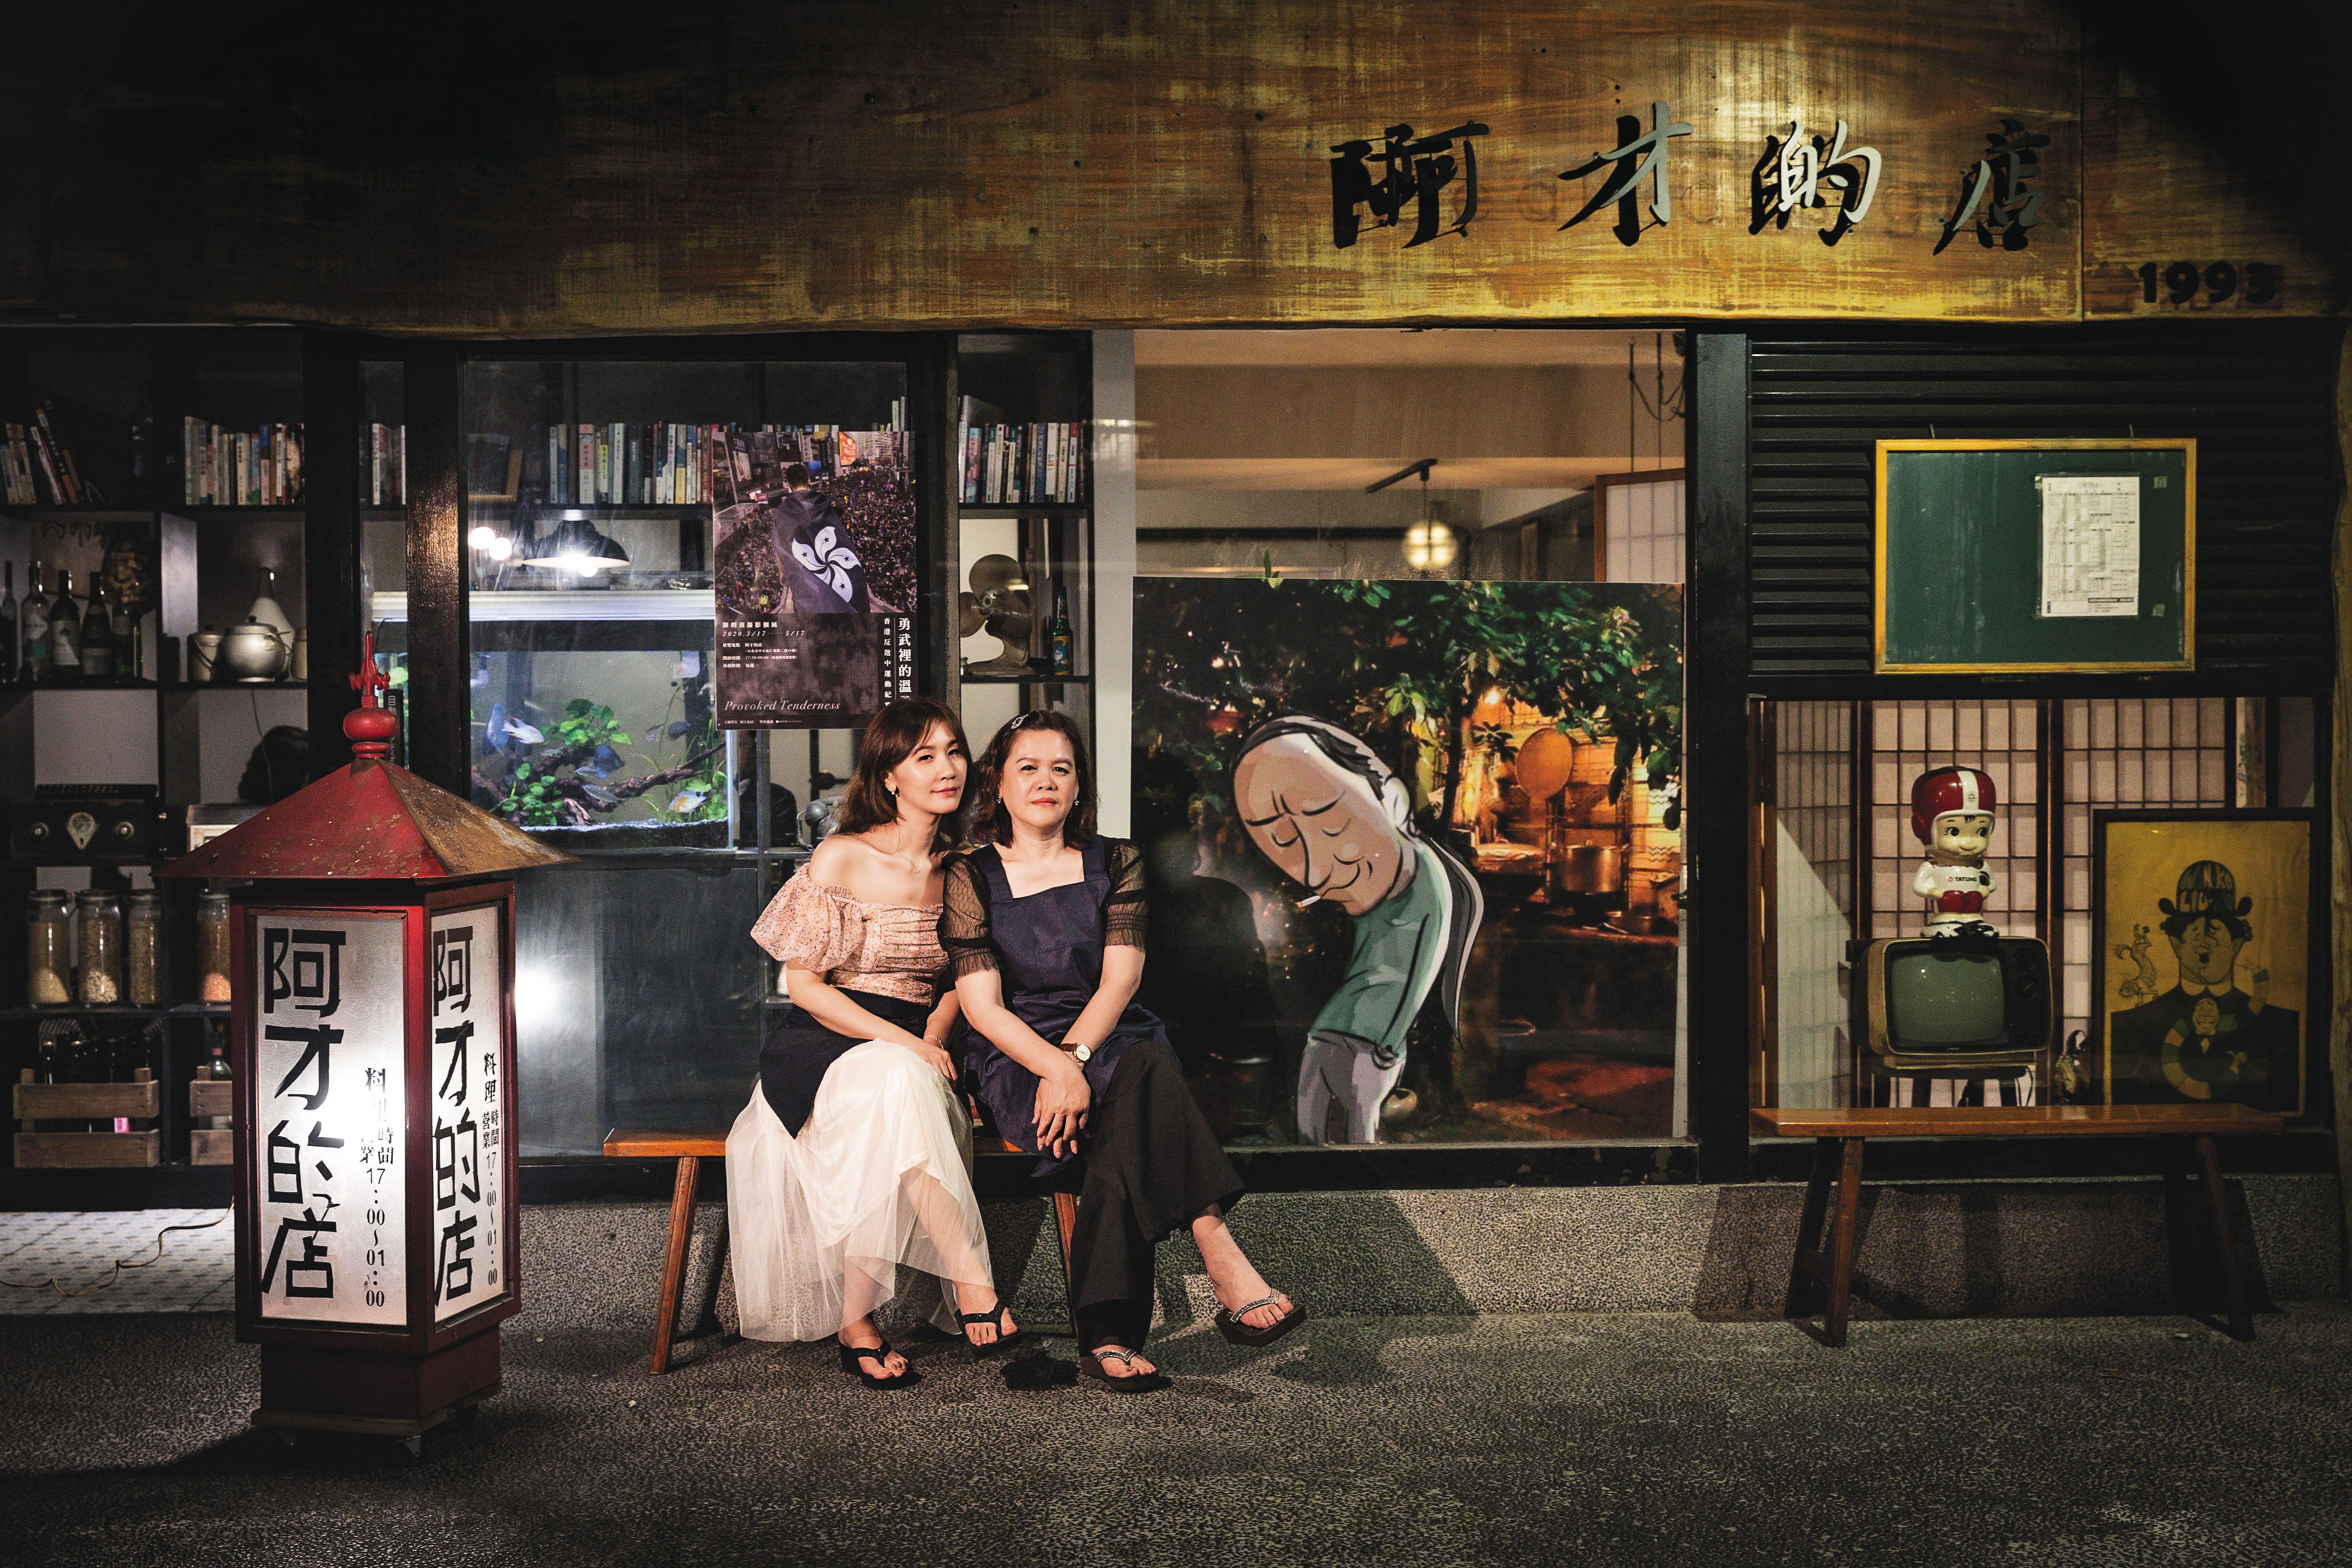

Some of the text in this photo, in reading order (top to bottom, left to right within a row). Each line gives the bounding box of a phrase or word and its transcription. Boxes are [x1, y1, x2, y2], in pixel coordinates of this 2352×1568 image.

[1331, 100, 2051, 254] 阿才的店
[2138, 261, 2277, 304] 1993
[725, 700, 840, 711] Provoked Tenderness
[898, 617, 912, 700] 勇武裡的溫
[260, 928, 346, 1299] 阿才的店
[432, 926, 480, 1307] 阿才的店
